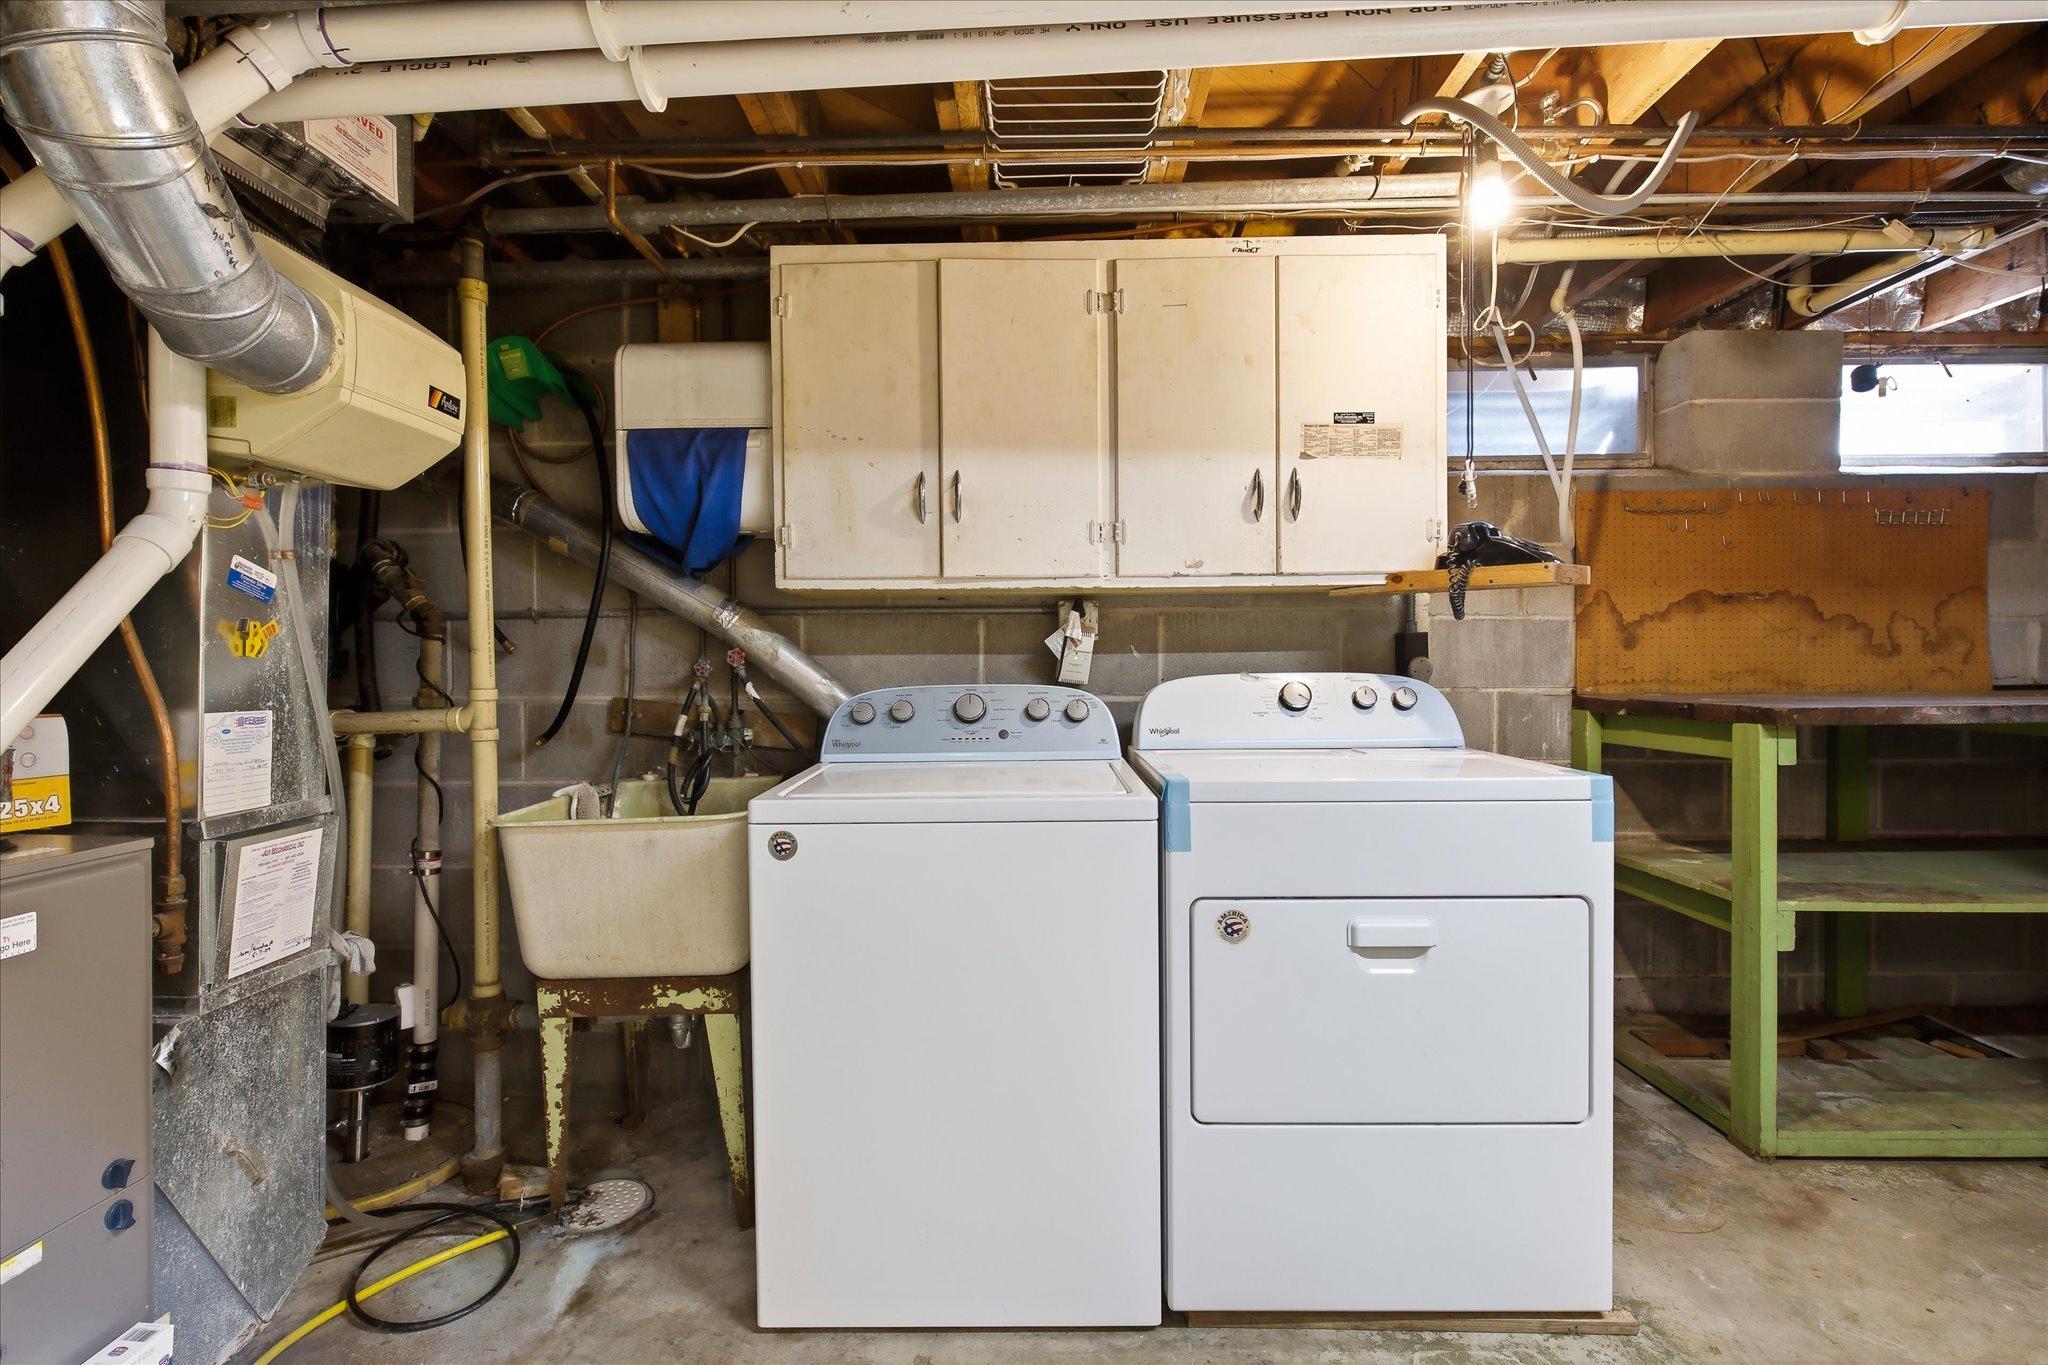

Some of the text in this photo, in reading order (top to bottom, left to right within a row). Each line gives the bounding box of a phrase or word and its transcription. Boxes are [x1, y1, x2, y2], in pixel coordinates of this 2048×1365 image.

[1345, 8, 1392, 17] NON
[1145, 17, 1189, 27] USE
[1207, 11, 1329, 25] PRESSURE
[1066, 20, 1127, 32] ONLY
[380, 61, 451, 73] EAGLE
[467, 57, 497, 67] JM
[1149, 726, 1180, 737] Whirlpool
[831, 741, 861, 749] Whirlpool
[1217, 910, 1248, 925] AMERICA
[12, 939, 31, 949] Here
